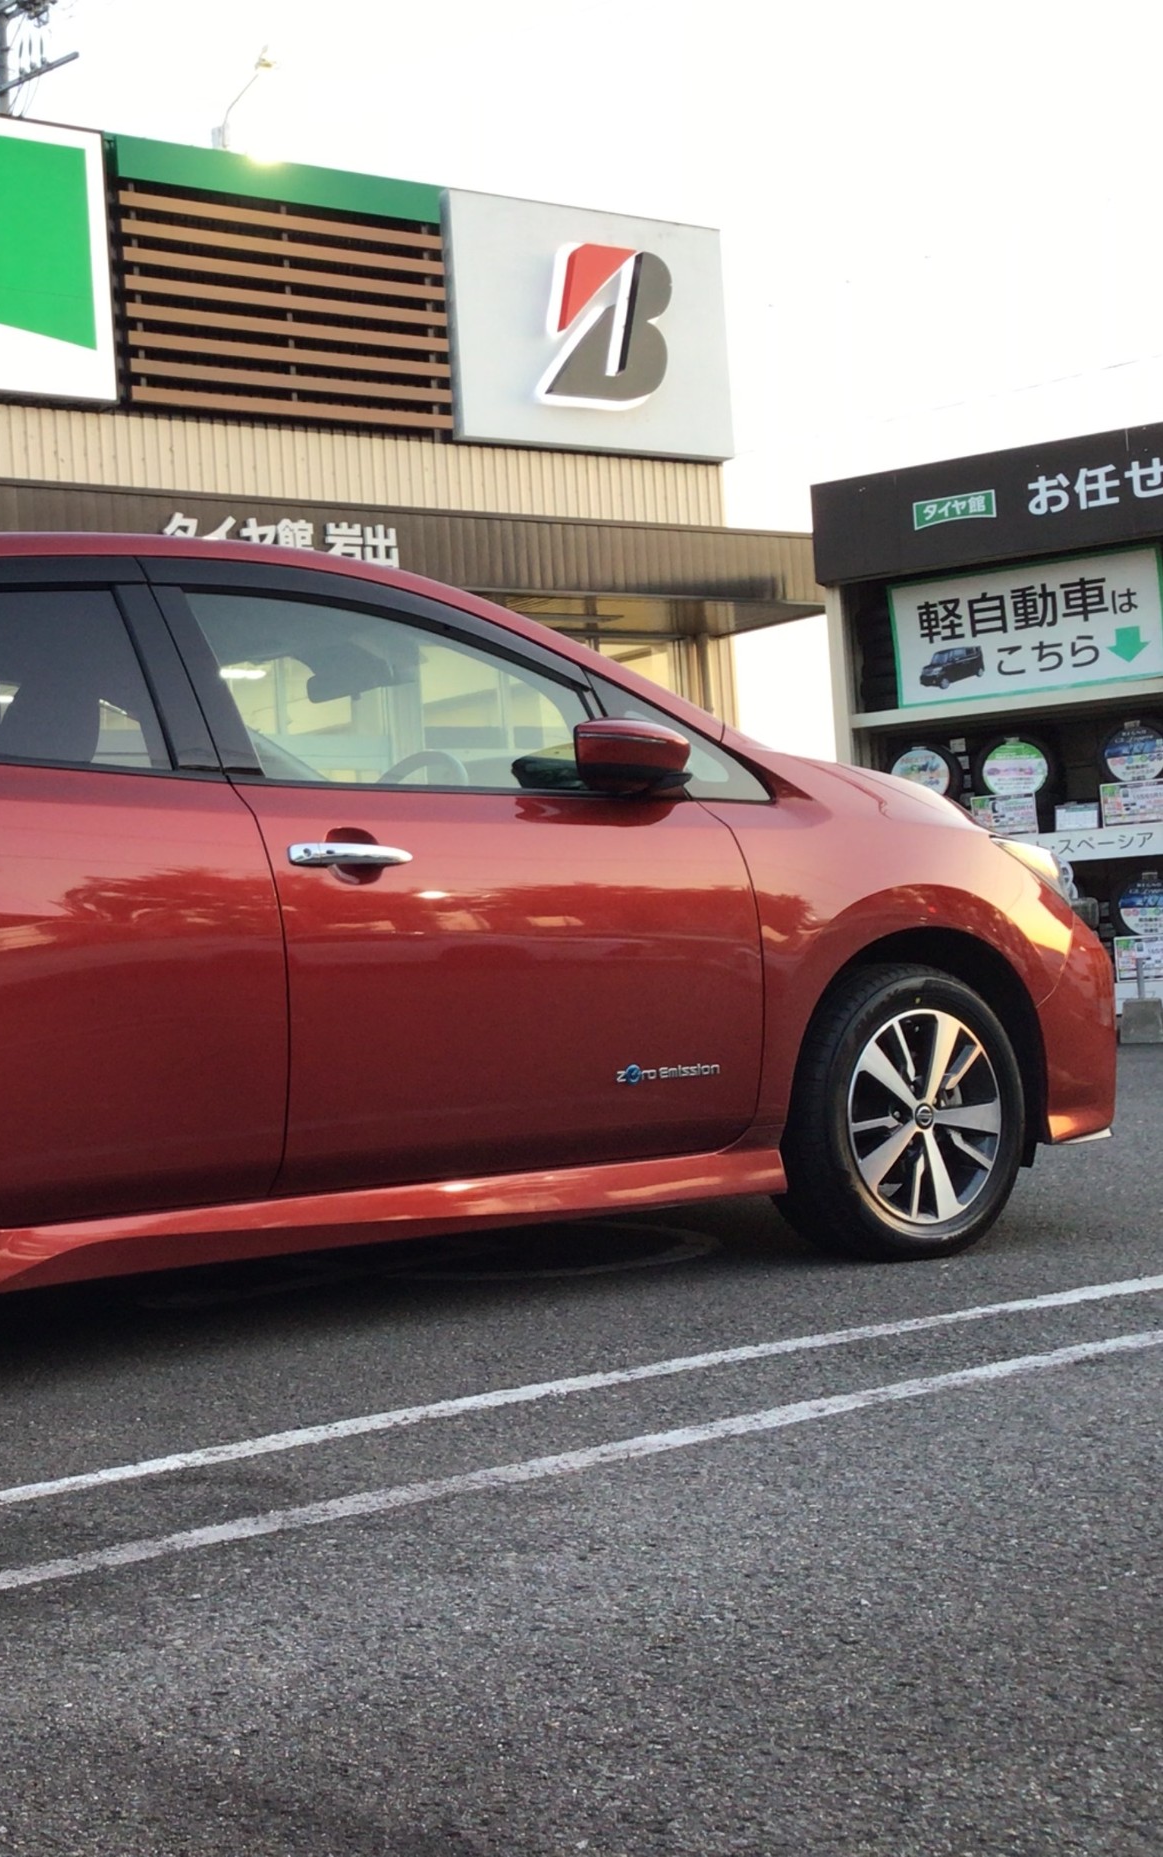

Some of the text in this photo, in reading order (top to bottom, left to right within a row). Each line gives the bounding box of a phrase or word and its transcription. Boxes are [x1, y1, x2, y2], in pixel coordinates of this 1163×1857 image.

[923, 494, 987, 521] タイヤ館
[1027, 458, 1163, 516] お任せ
[324, 521, 400, 569] 岩出
[916, 576, 1138, 644] 軽自動車は
[996, 634, 1100, 676] こちら
[659, 1063, 721, 1080] Emission
